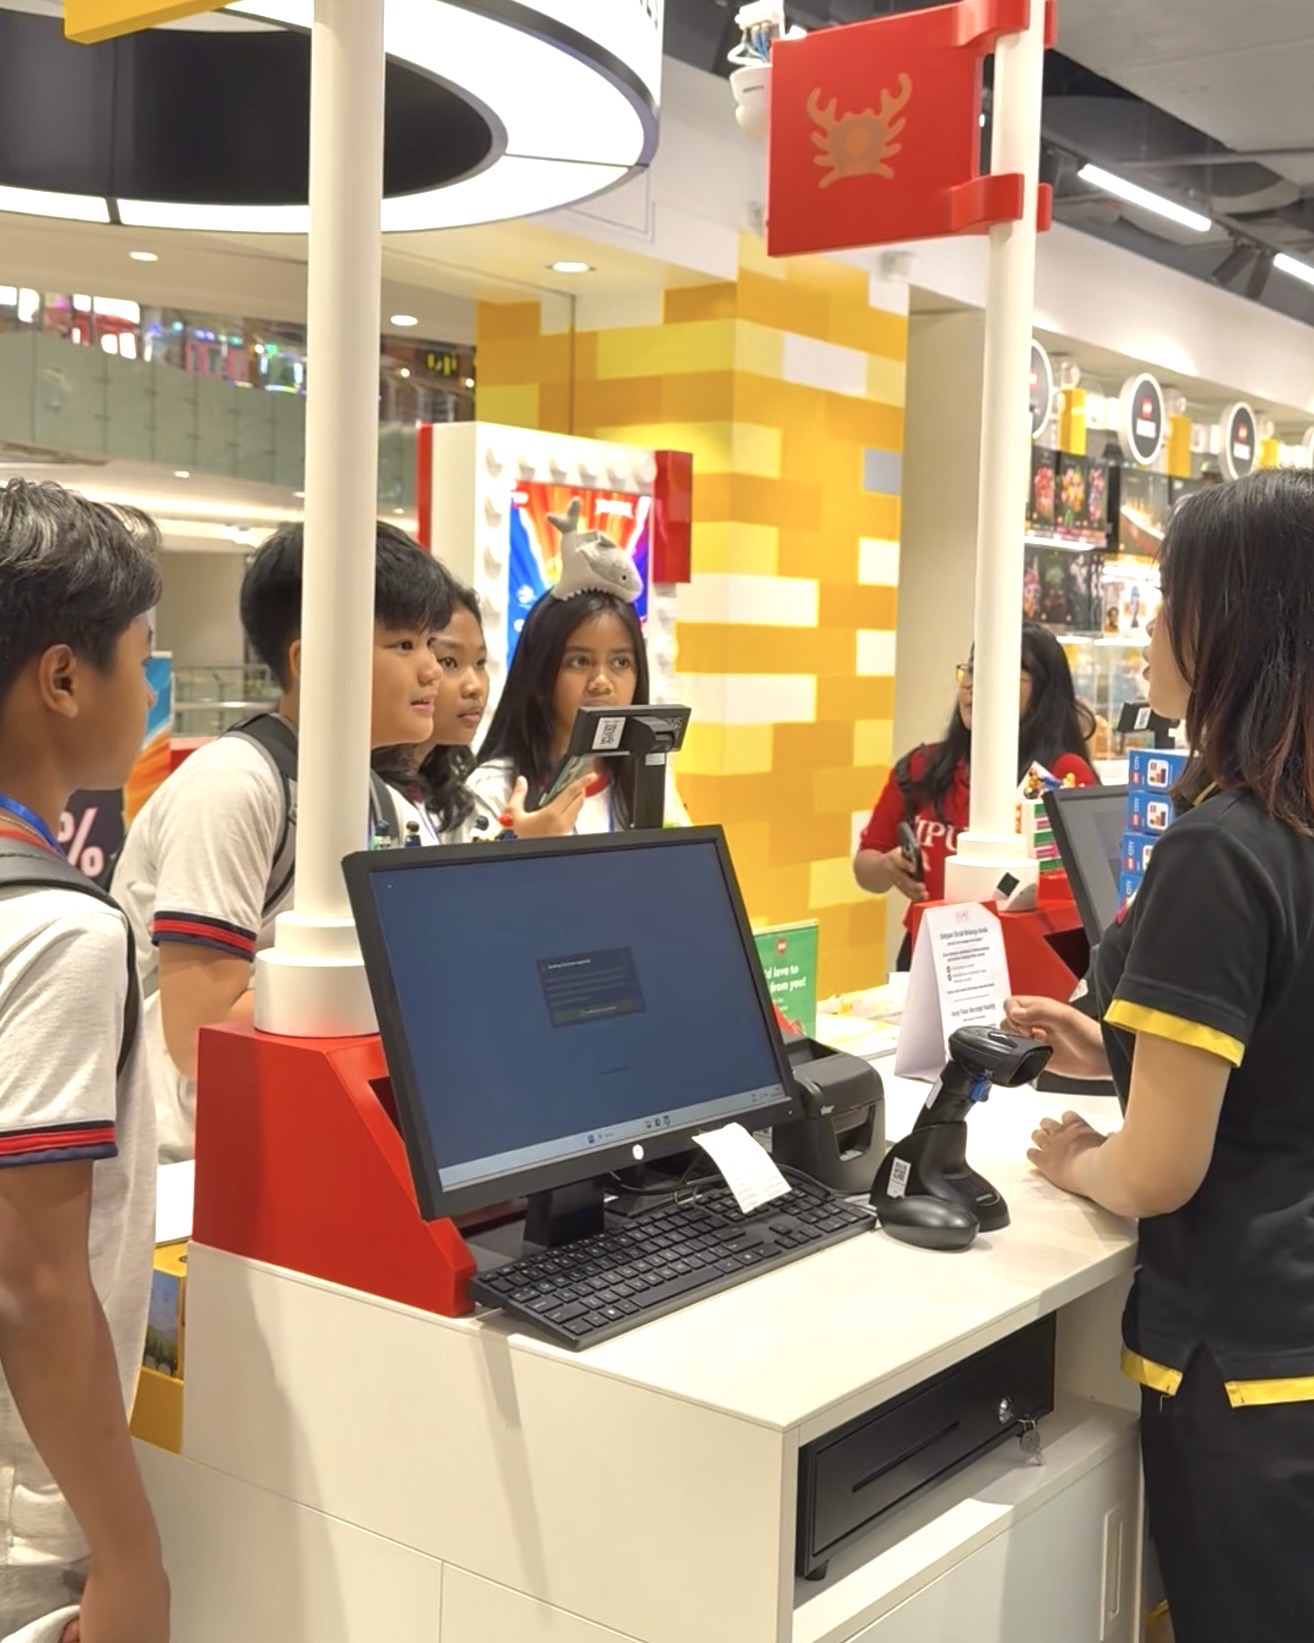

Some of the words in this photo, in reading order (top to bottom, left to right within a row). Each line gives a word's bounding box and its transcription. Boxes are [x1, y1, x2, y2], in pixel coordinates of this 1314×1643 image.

[58, 806, 104, 878] %
[773, 966, 788, 978] love
[790, 965, 799, 975] to
[770, 981, 788, 993] from
[789, 976, 806, 992] you!
